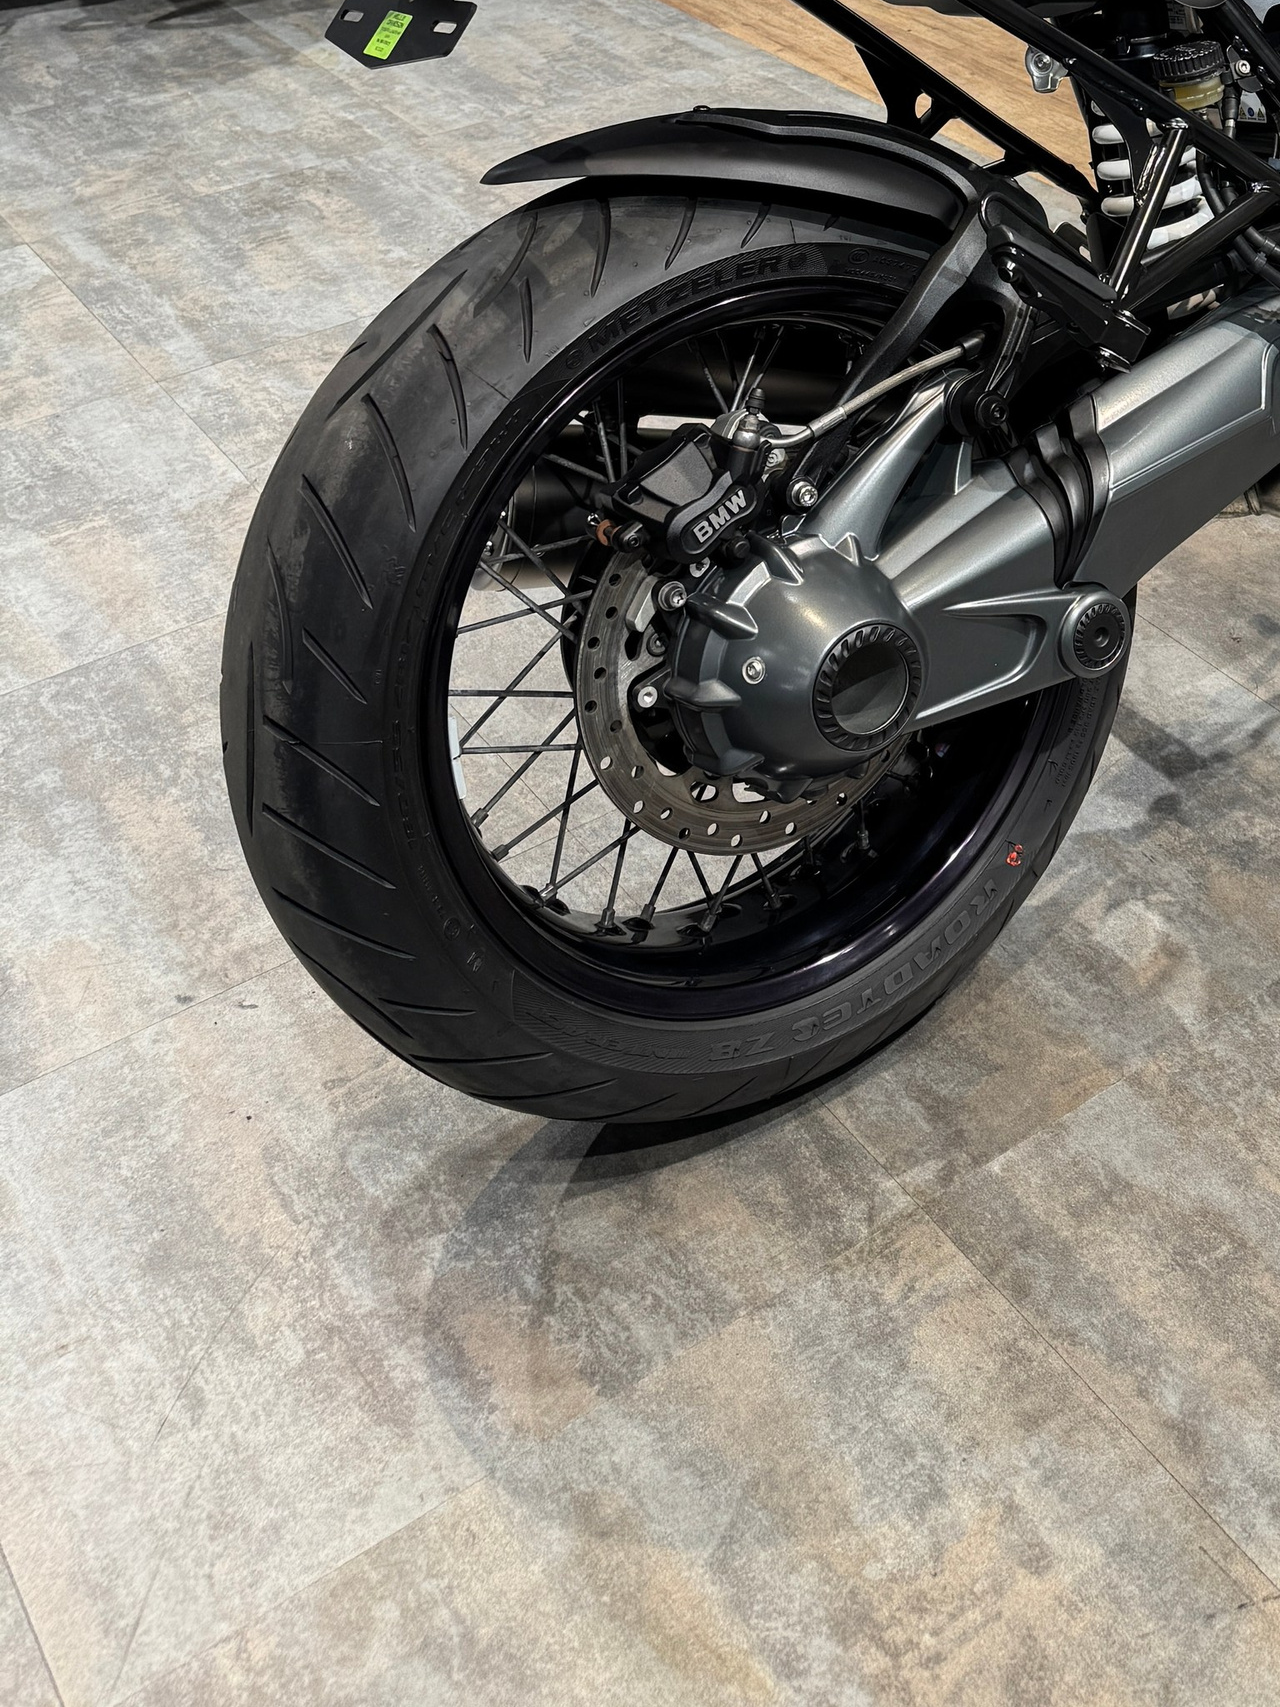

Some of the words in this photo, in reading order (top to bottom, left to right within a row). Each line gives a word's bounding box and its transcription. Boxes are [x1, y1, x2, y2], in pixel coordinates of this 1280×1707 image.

[585, 254, 781, 353] METZELER
[693, 489, 747, 543] BMW
[791, 877, 1001, 1044] ROADTEC
